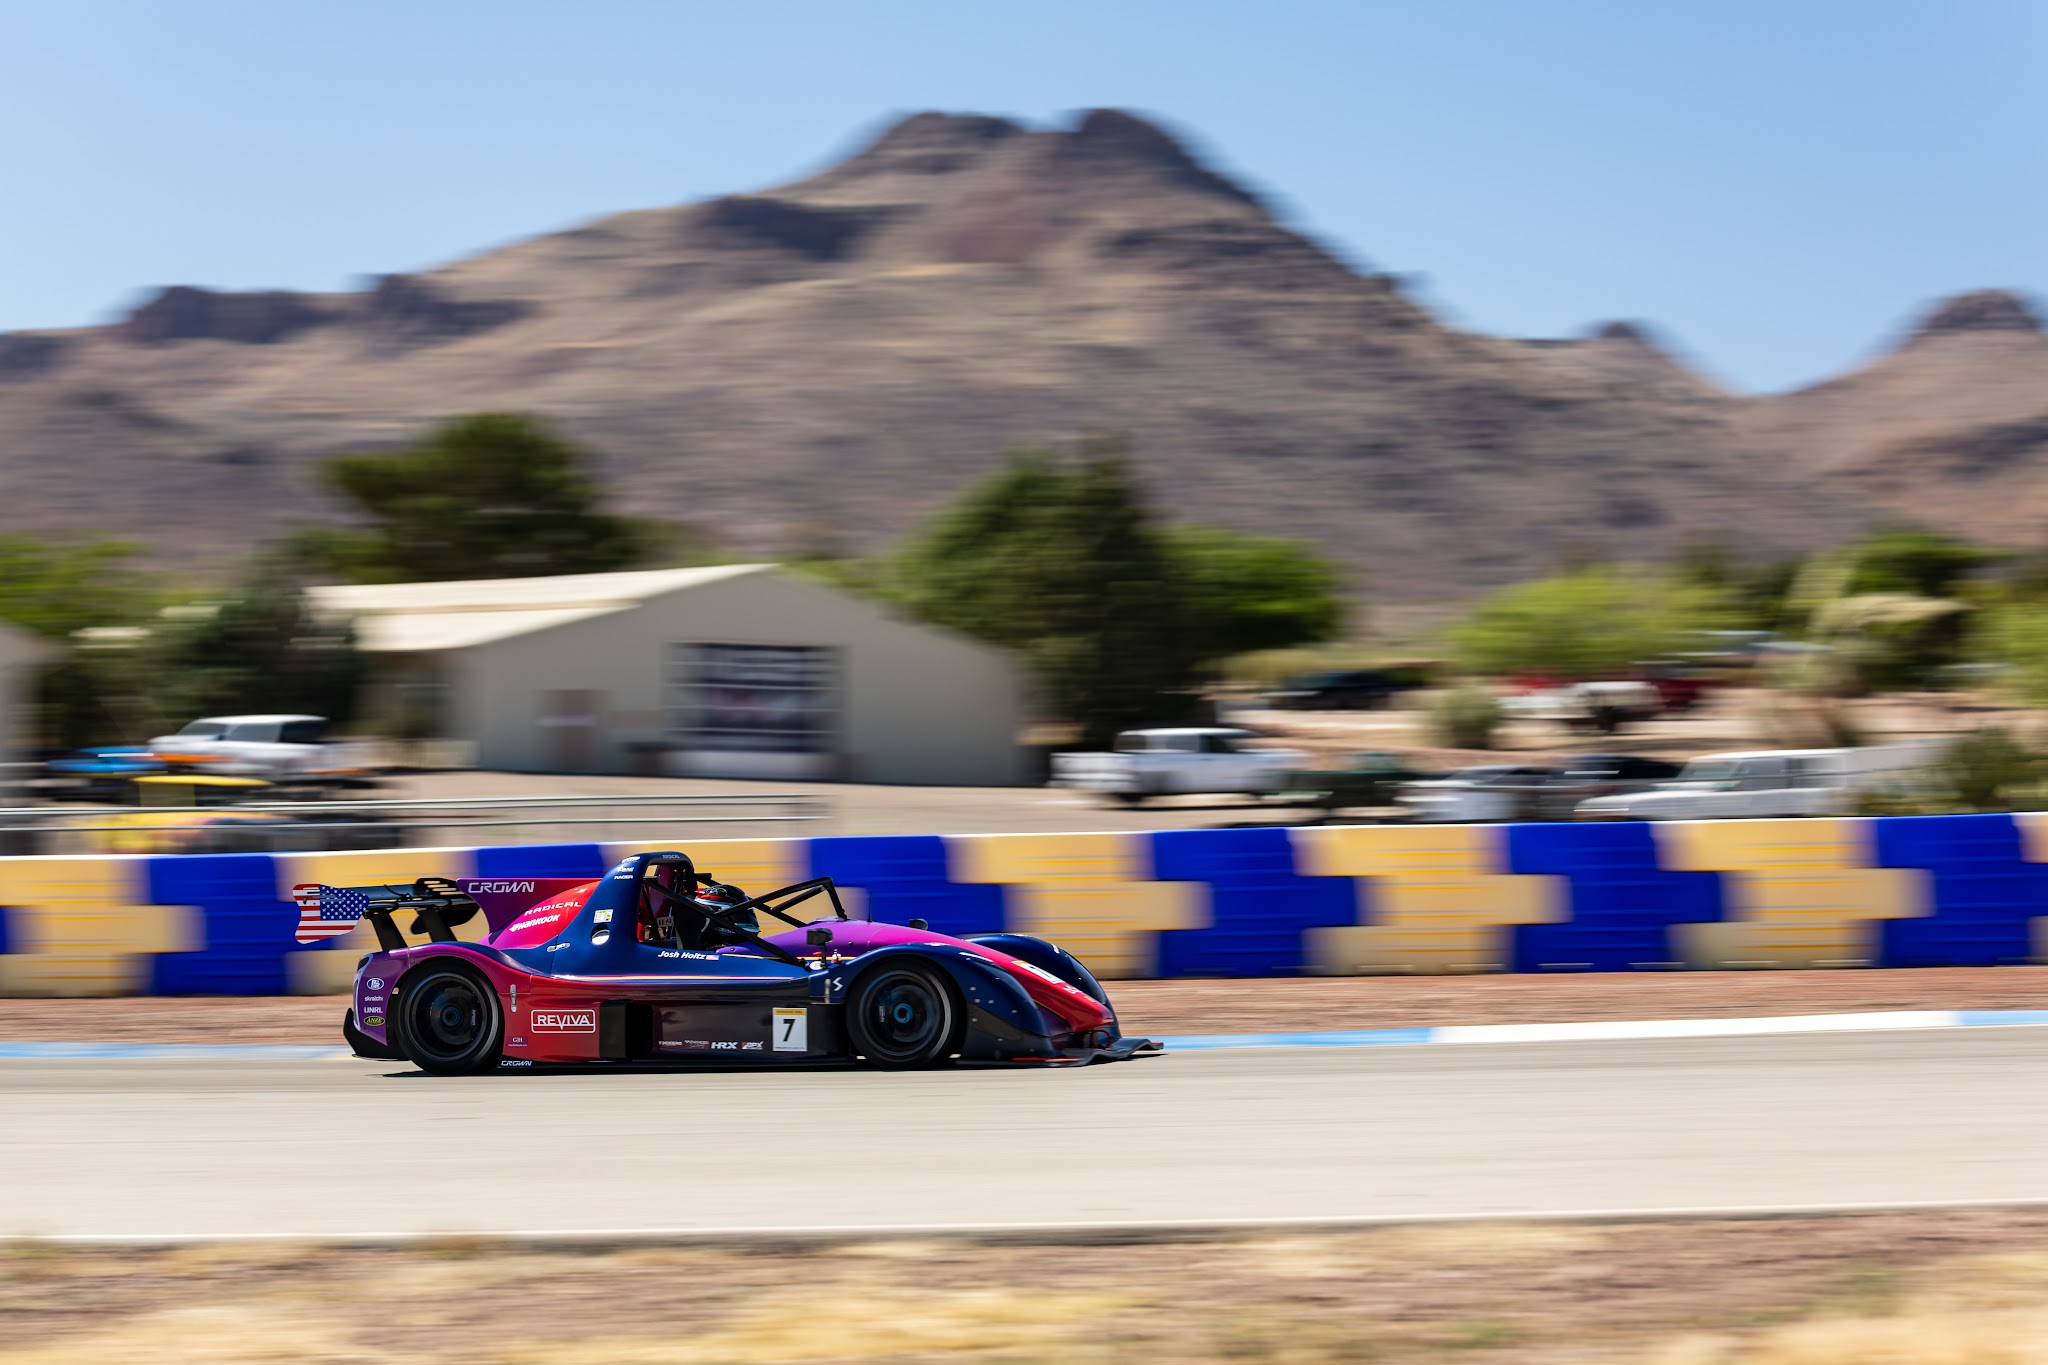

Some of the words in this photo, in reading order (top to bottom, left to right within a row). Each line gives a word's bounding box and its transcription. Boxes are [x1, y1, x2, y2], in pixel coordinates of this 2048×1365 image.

[468, 882, 535, 893] CROWN
[524, 901, 583, 916] RADICAL
[680, 952, 706, 960] Holtz
[537, 1014, 590, 1030] REVIVA
[783, 1018, 796, 1042] 7
[711, 1041, 738, 1049] HRX
